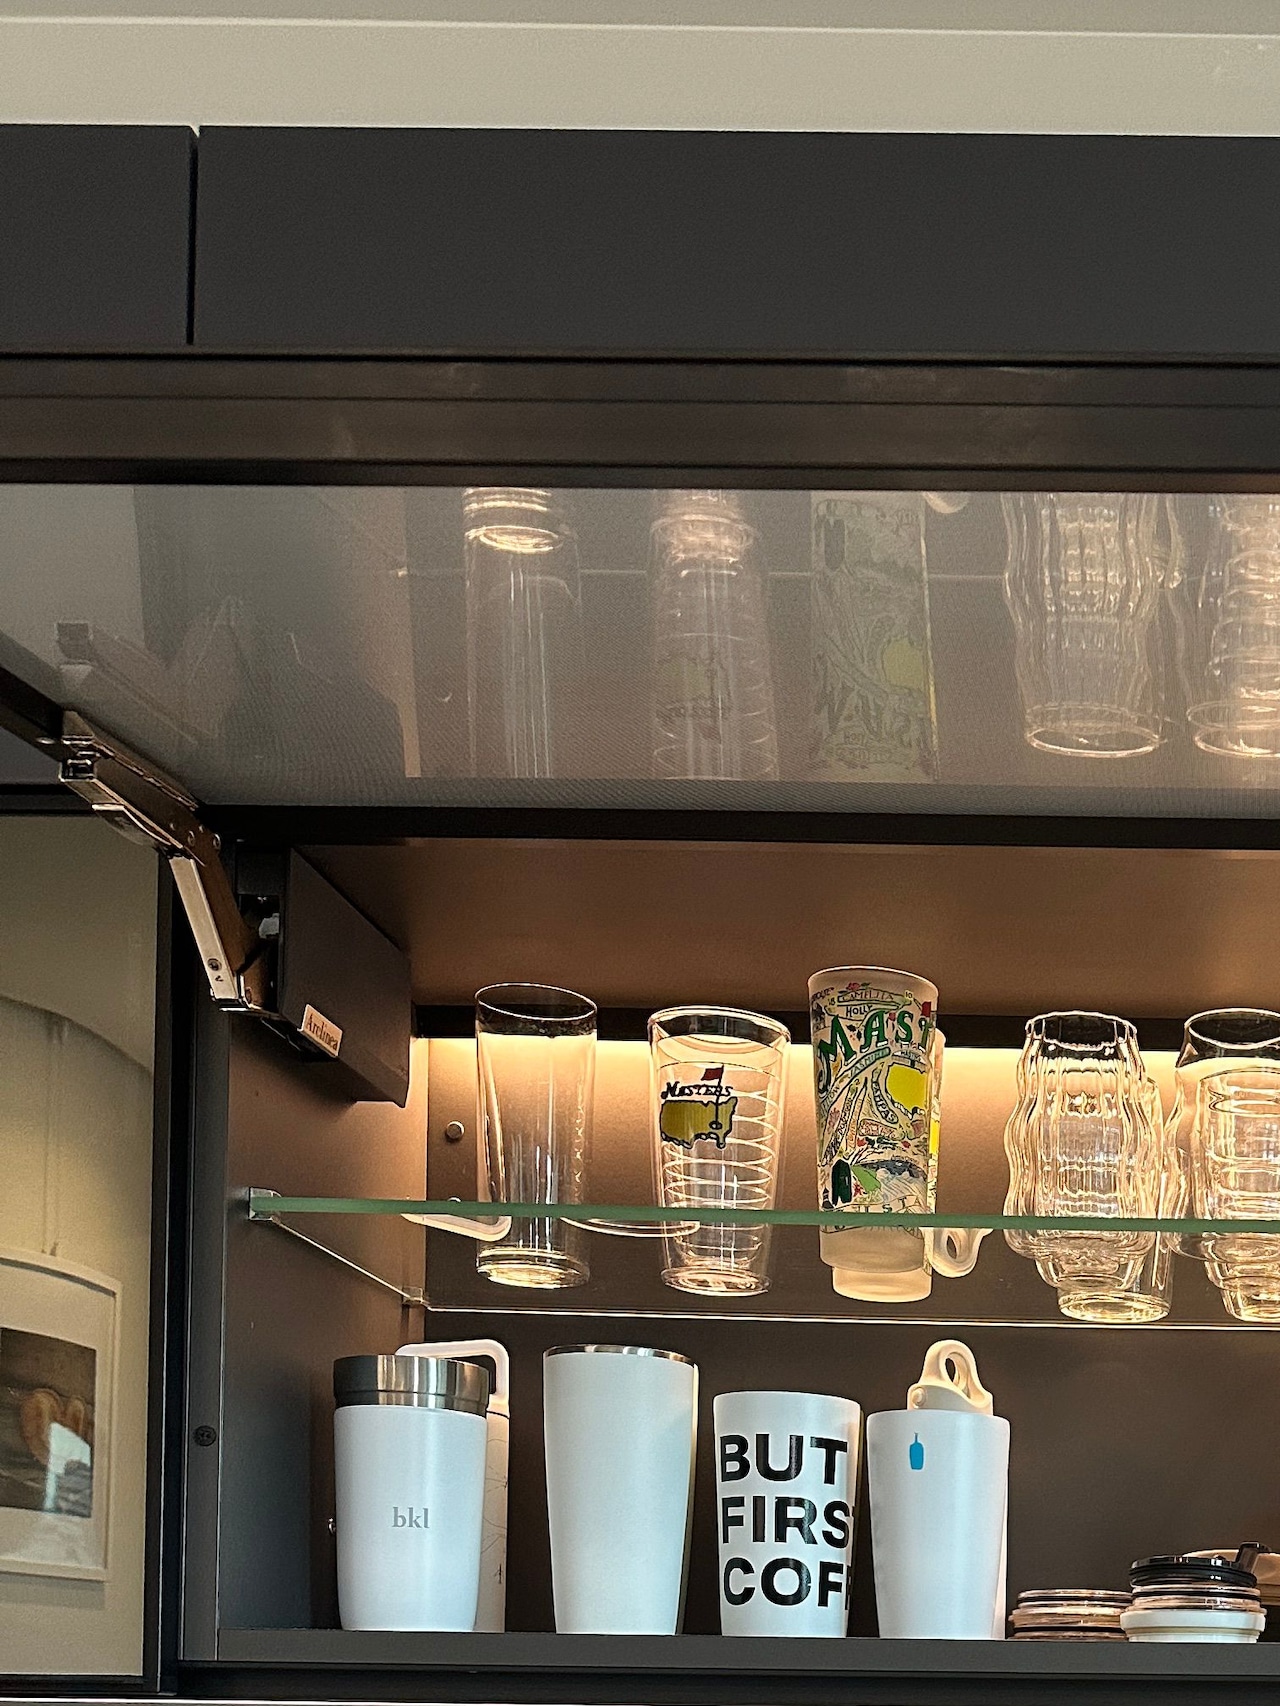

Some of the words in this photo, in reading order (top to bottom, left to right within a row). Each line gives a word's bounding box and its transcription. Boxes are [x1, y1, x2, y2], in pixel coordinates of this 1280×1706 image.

[846, 1004, 872, 1017] HOLLY
[720, 1434, 848, 1485] BUT
[392, 1506, 430, 1528] bkl
[721, 1495, 855, 1549] FIRS
